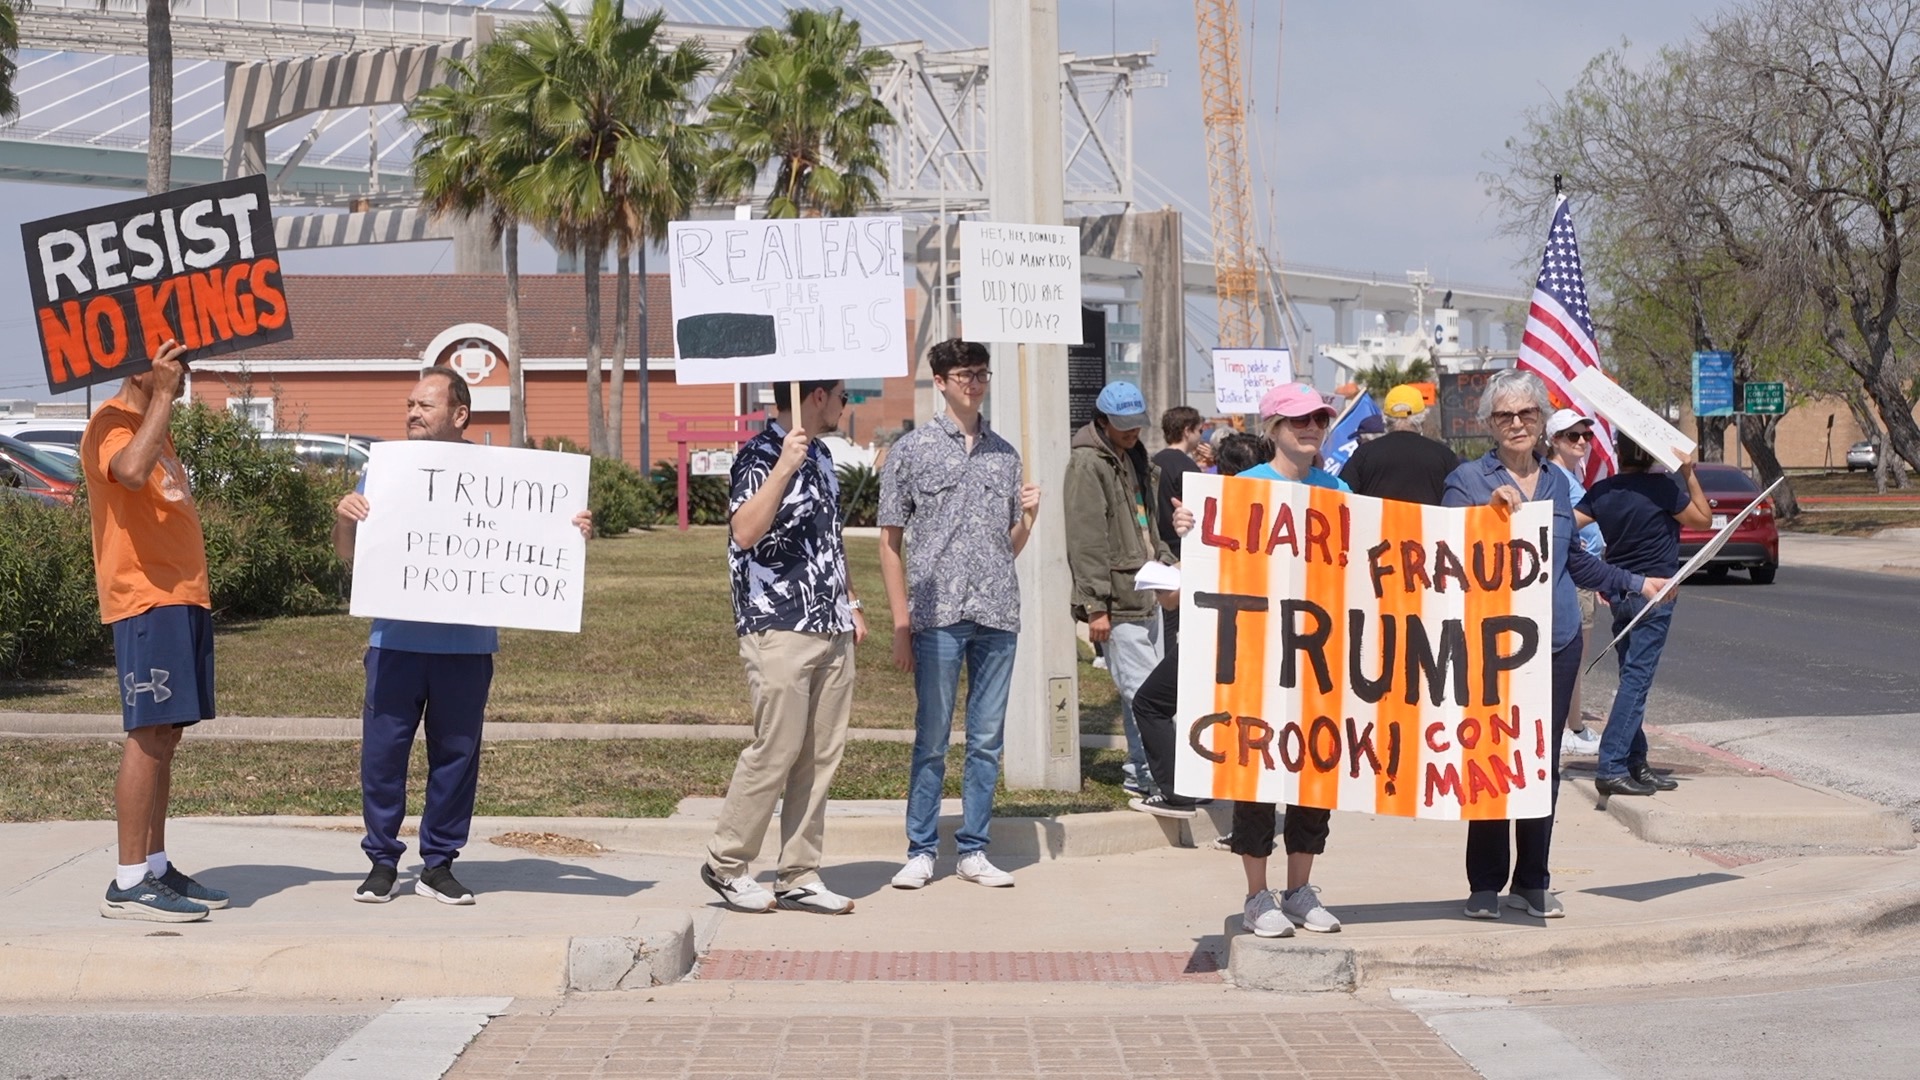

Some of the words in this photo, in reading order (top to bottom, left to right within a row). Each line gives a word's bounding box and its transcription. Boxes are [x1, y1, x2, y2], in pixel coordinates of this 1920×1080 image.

[38, 193, 258, 302] RESIST
[676, 219, 901, 288] REALEASE
[980, 228, 1006, 242] HEY,
[1009, 229, 1026, 244] HEY,
[1029, 231, 1057, 244] DONALD
[981, 247, 1014, 268] HOW
[1020, 252, 1047, 268] MANY
[1049, 252, 1072, 270] KIDS
[751, 282, 819, 309] THE
[982, 280, 1006, 303] DID
[1011, 281, 1036, 304] YOU
[1041, 284, 1064, 301] RAPE
[39, 295, 128, 384] NO
[134, 258, 287, 360] KINGS
[776, 298, 892, 357] FILES
[998, 307, 1060, 334] TODAY?
[418, 468, 568, 513] TRUMP
[463, 511, 498, 531] the
[1201, 497, 1350, 568] LIAR!
[407, 531, 571, 571] PEDOPHILE
[1368, 526, 1549, 598] FRAUD!
[402, 565, 567, 601] PROTECTOR
[1193, 591, 1539, 707] TRUMP
[1425, 705, 1520, 752] CON
[1189, 711, 1400, 796] CROOK!
